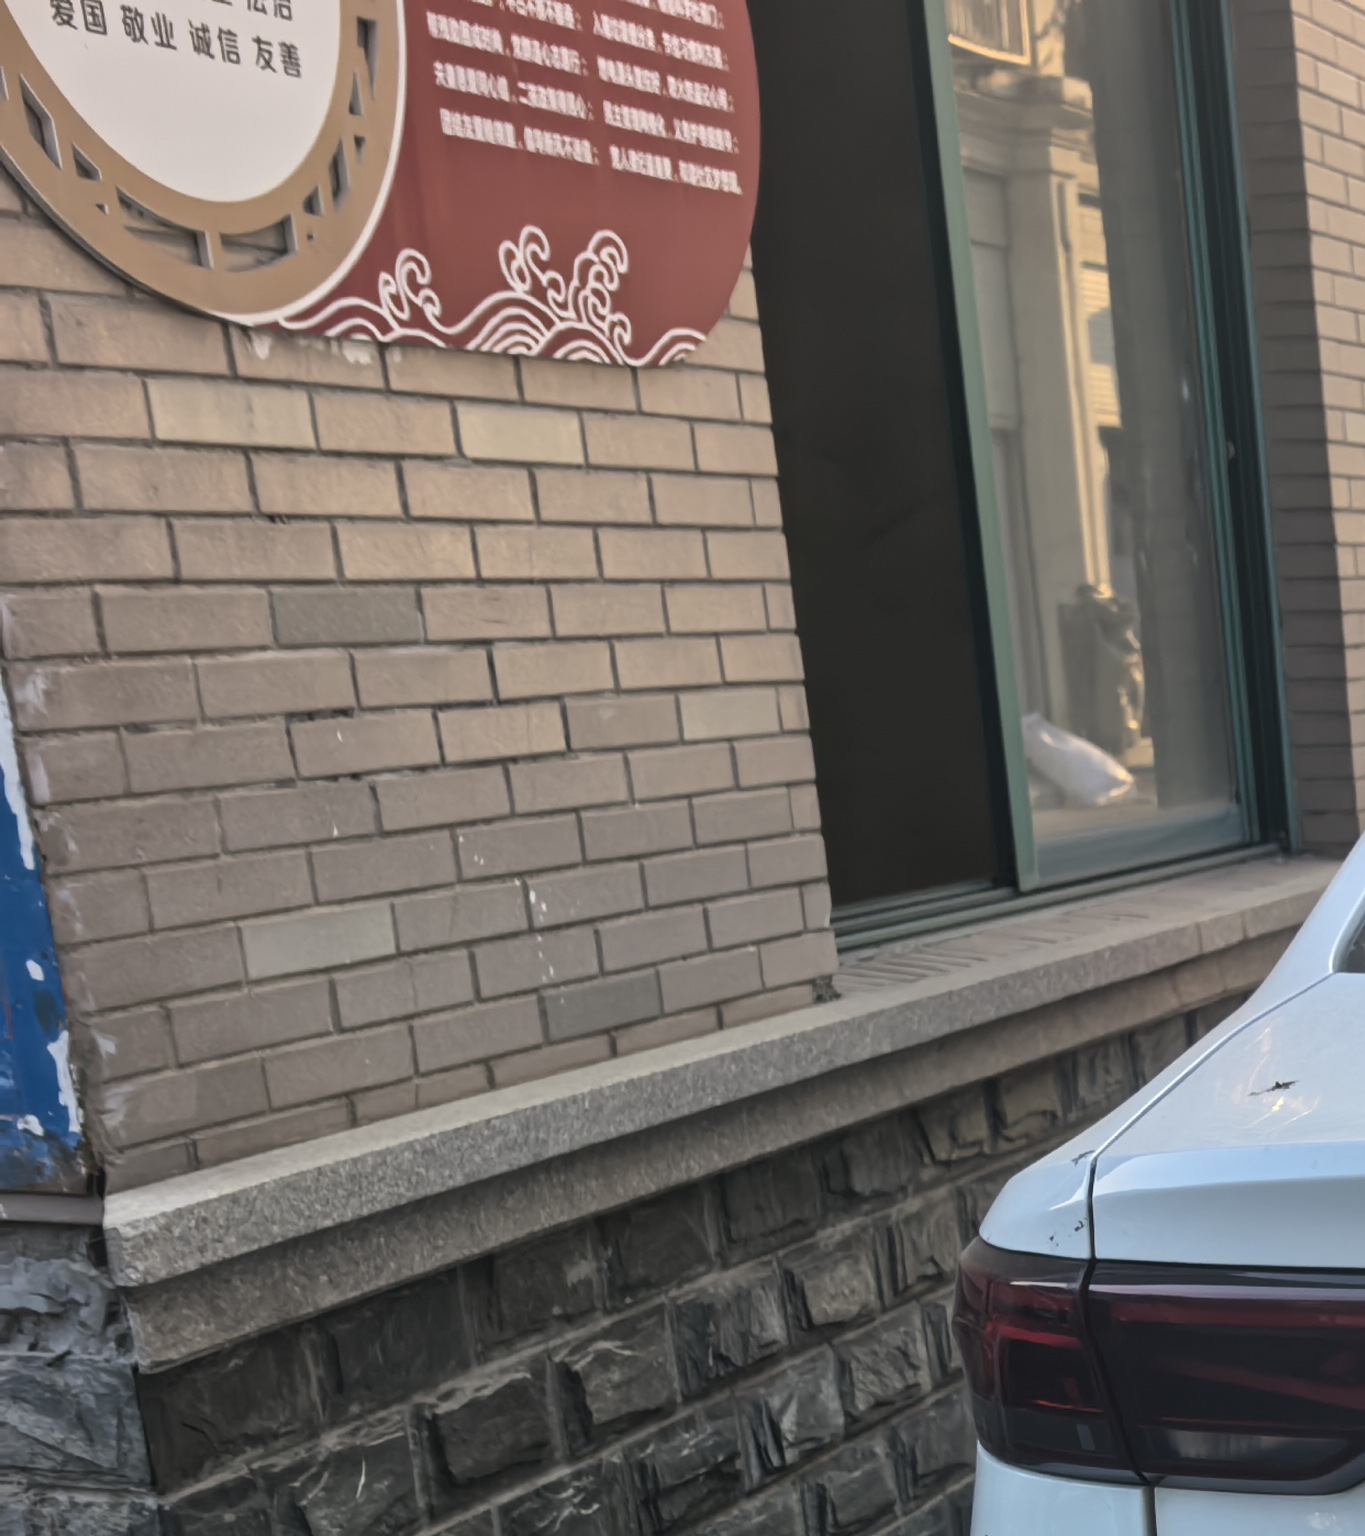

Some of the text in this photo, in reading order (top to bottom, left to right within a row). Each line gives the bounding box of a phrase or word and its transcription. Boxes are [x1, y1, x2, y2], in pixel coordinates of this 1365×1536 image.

[50, 0, 302, 78] 爱国 敬业 诚信 友善
